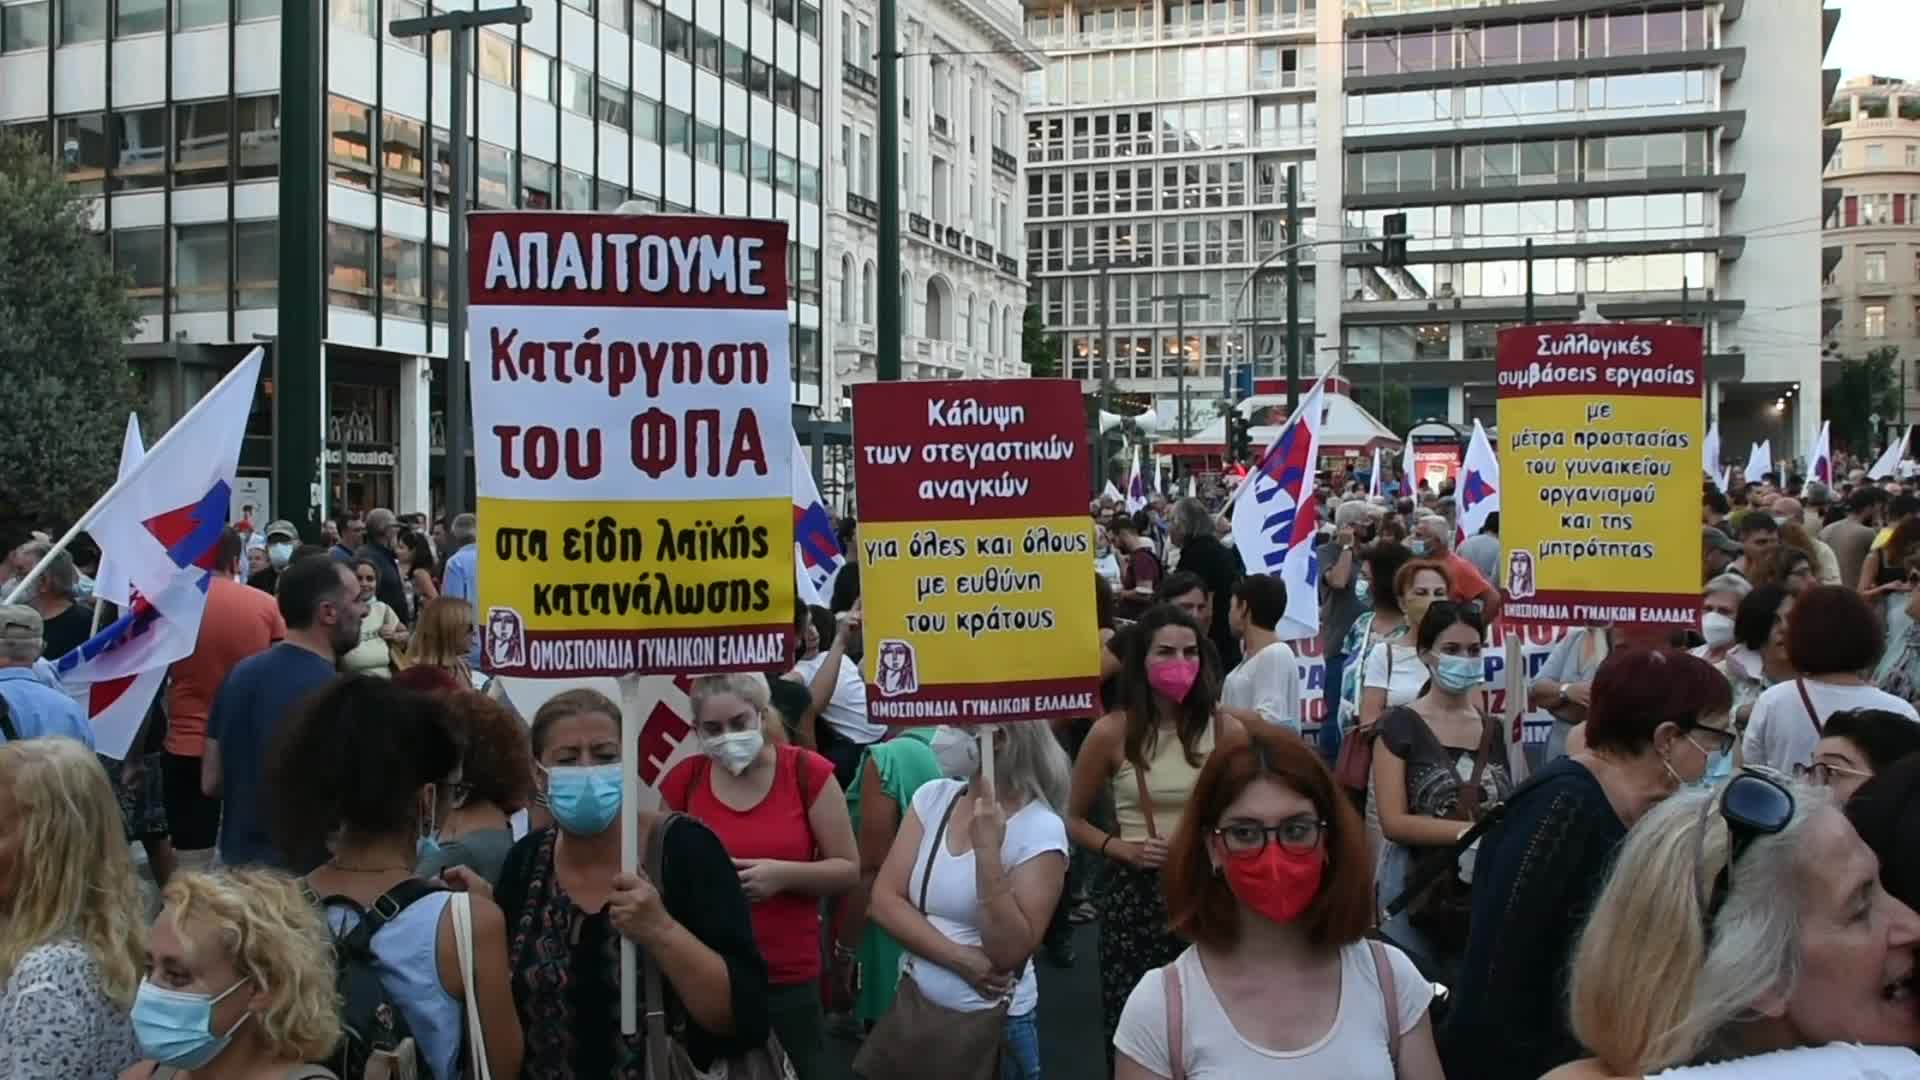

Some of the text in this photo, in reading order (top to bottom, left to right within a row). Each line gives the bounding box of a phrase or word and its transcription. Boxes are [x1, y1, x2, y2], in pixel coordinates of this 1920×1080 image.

[485, 230, 768, 296] ΑΠΑΙΤΟΥΜΕ
[489, 326, 769, 398] Κατάργηση
[1537, 333, 1652, 359] Συλλογικές
[1498, 363, 1695, 389] συμβάσεις εργασίας
[927, 397, 1025, 432] Κάλυψη
[1586, 402, 1611, 423] με
[493, 406, 768, 480] του ΦΠΑ
[864, 434, 1074, 469] των στεγαστικών
[1511, 429, 1689, 451] μέτρα προστασίας
[1525, 456, 1671, 480] του γυναικείου
[918, 471, 1029, 506] αναγκών
[1540, 485, 1656, 507] οργανισμού
[1560, 513, 1632, 530] και της
[495, 516, 769, 564] στα είδη λαϊκής
[864, 527, 1088, 564] για όλες και όλους
[1539, 537, 1653, 561] μητρότητας
[533, 571, 770, 617] κατανάλωσης
[916, 568, 1041, 601] με ευθύνη
[906, 606, 1054, 638] του κράτους
[1573, 605, 1636, 622] ΓΥΝΑΙΚΩΝ
[1640, 607, 1696, 623] ΕΛΛΑΔΑΣ
[530, 633, 785, 671] ΟΜΟΣΠΟΝΔΙΑ ΓΥΝΑΙΚΩΝ ΕΛΛΑΔΑΣ
[871, 693, 1093, 718] ΟΜΟΣΠΟΝΔΙΑ ΓΥΝΑΙΚΩΝ ΕΛΛΑΔΑΣ
